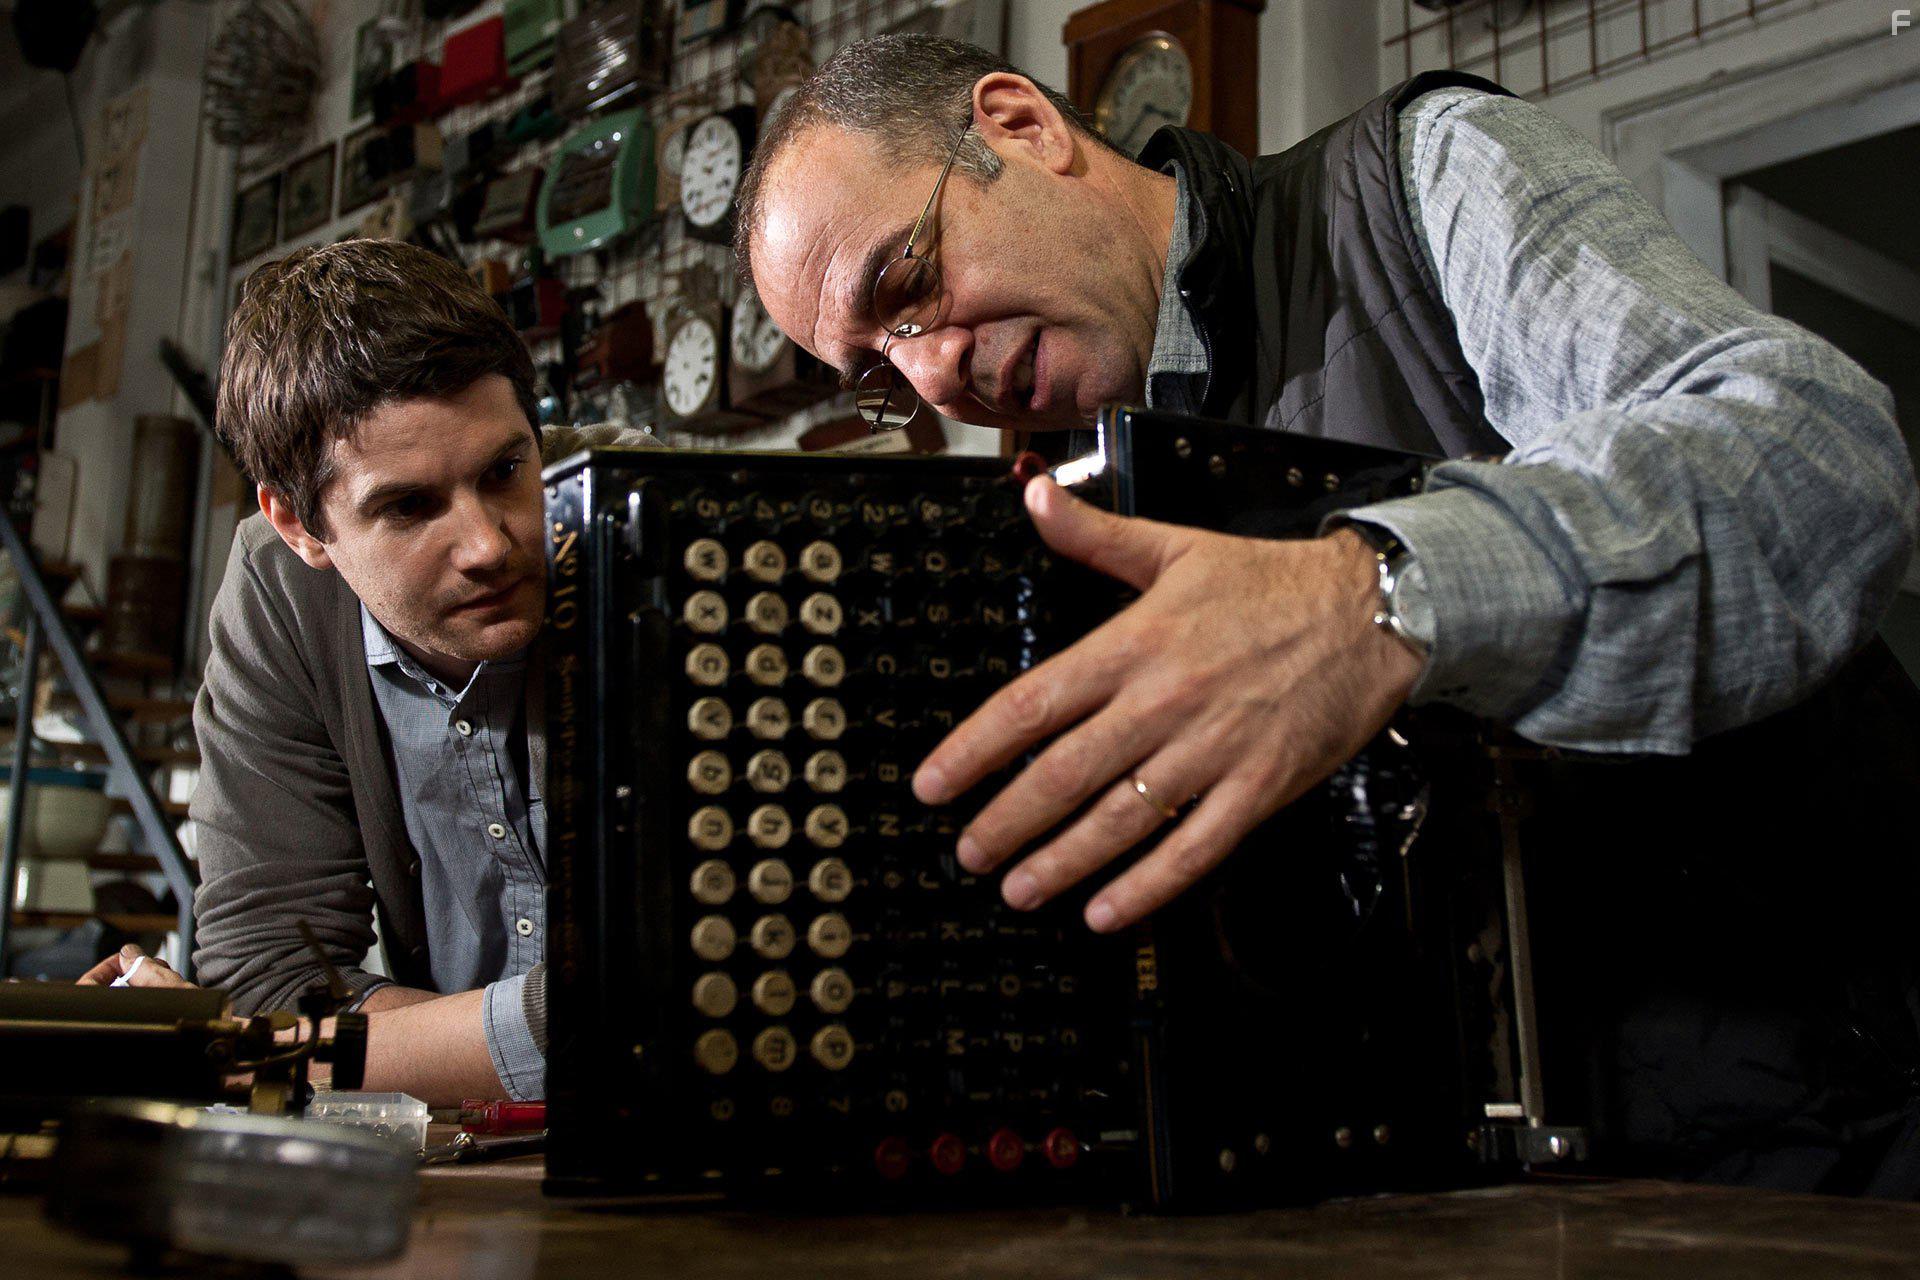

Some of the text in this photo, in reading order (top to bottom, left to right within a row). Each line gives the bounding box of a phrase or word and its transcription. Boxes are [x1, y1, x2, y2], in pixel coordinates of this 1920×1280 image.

[862, 502, 887, 524] 2
[870, 552, 895, 574] W
[552, 585, 578, 630] 10
[927, 603, 950, 623] S
[984, 606, 1005, 625] Z
[875, 654, 897, 675] C
[929, 657, 951, 679] D
[987, 656, 1008, 675] E
[873, 708, 896, 728] V
[878, 762, 900, 783] B
[878, 814, 901, 837] N
[999, 974, 1022, 999] O
[945, 1029, 966, 1056] M
[1002, 1032, 1023, 1052] P
